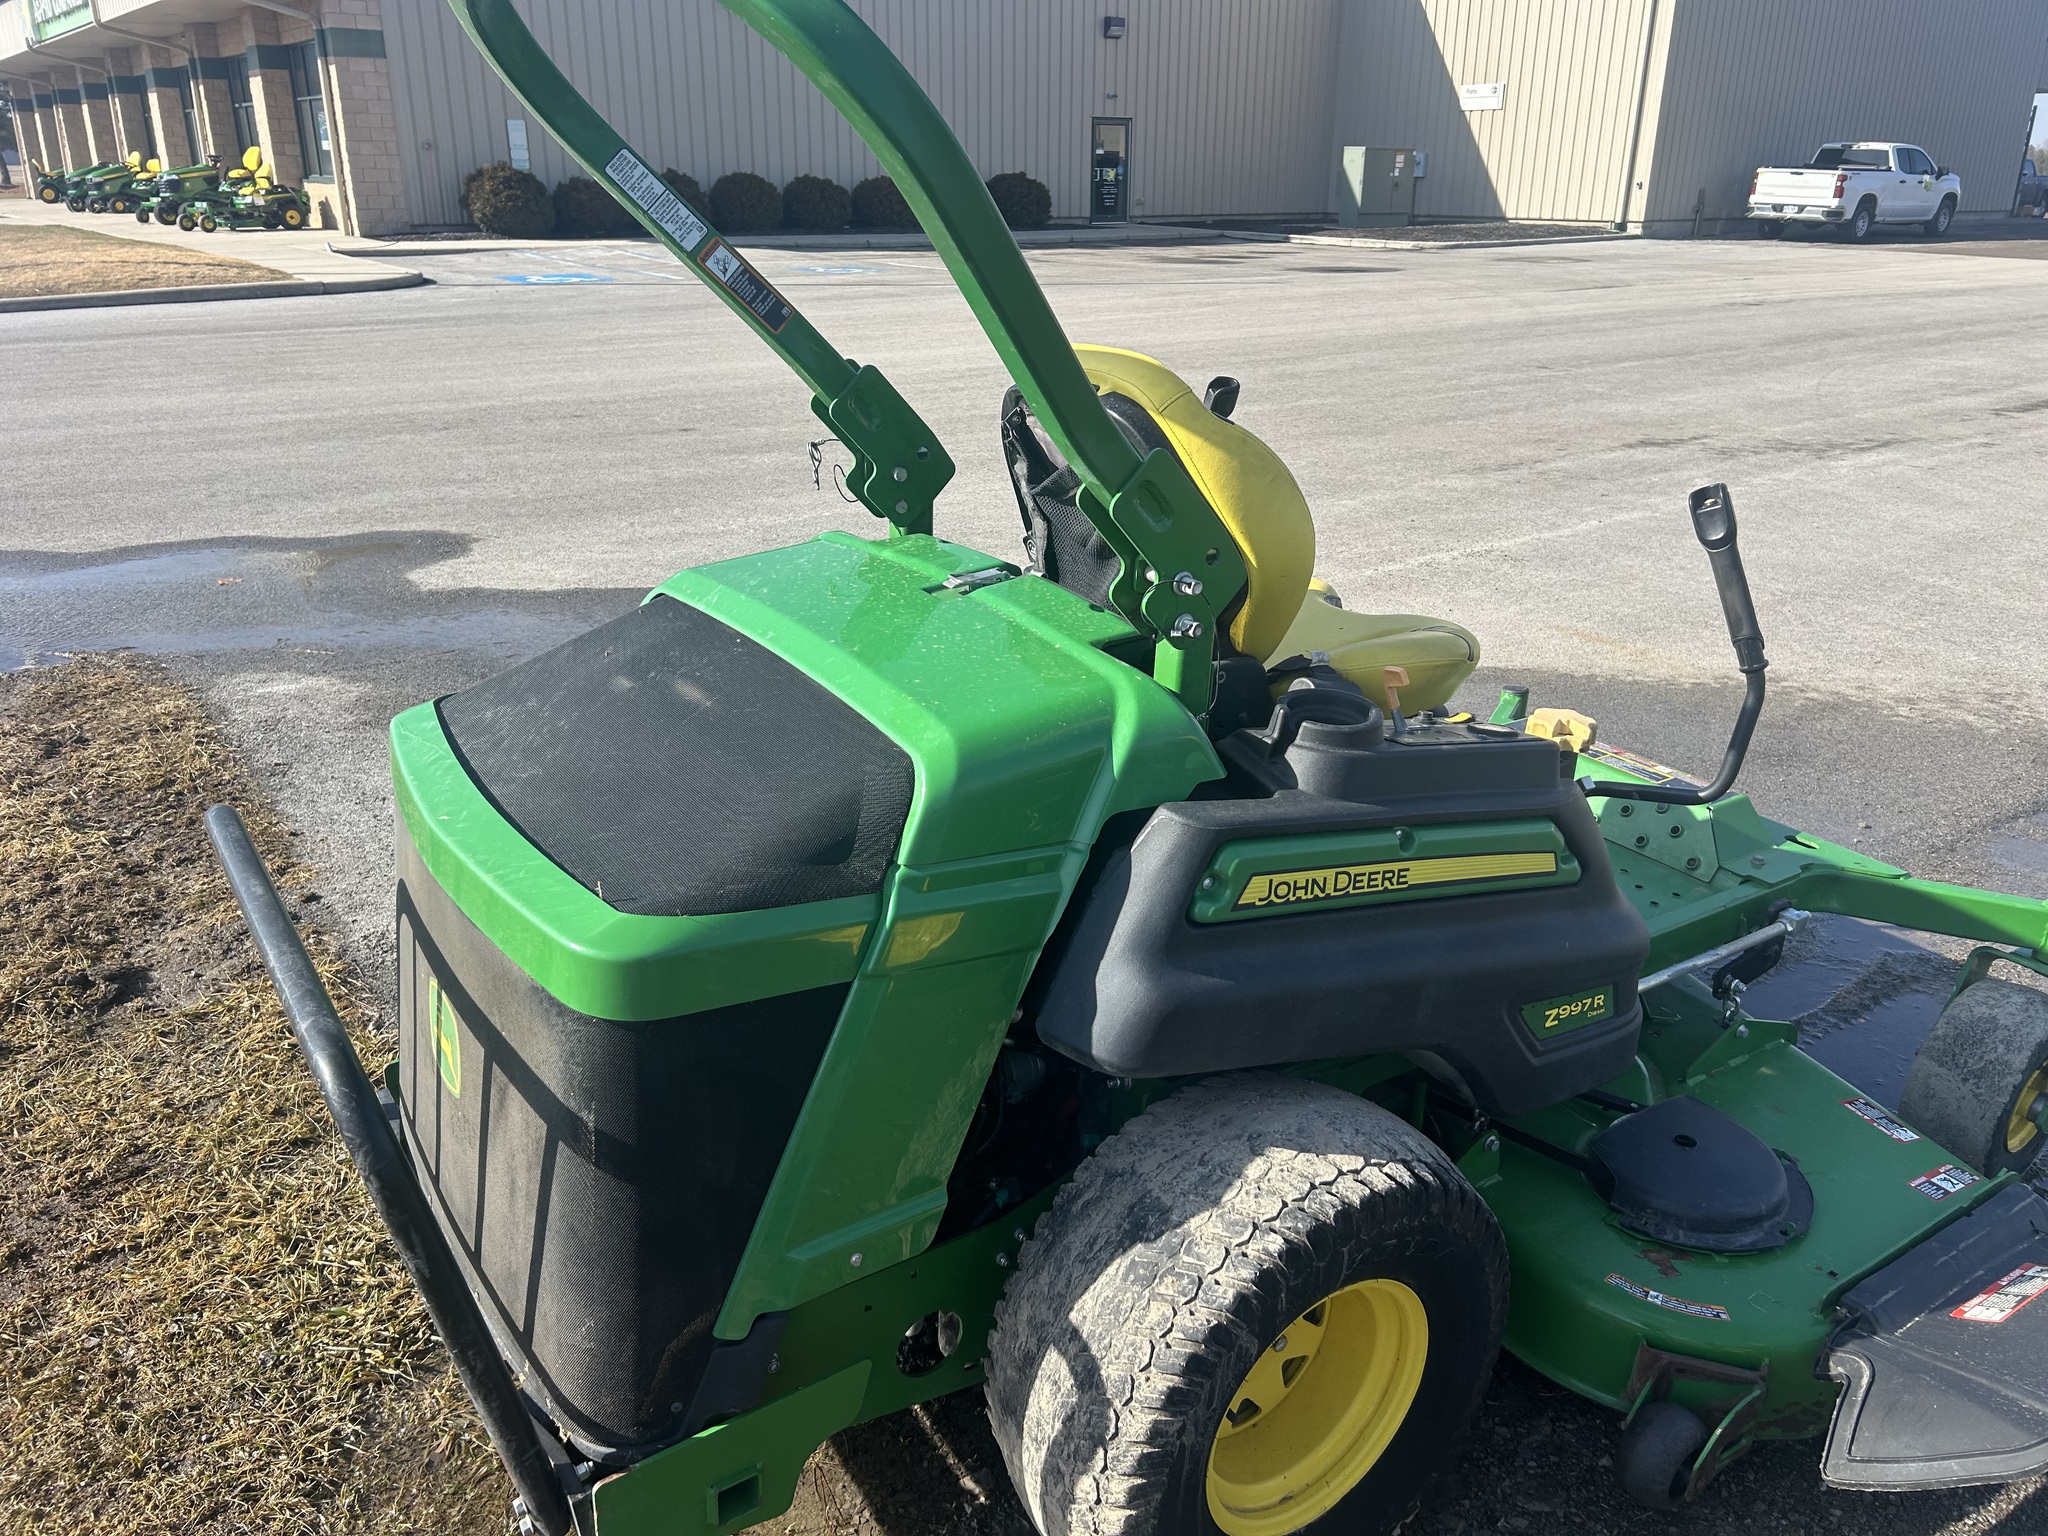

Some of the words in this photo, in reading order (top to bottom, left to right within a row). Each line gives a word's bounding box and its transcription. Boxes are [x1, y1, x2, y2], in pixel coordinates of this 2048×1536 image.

[1258, 876, 1328, 903] JOHN
[1332, 867, 1410, 893] DEERE
[1587, 1007, 1606, 1018] Diesel
